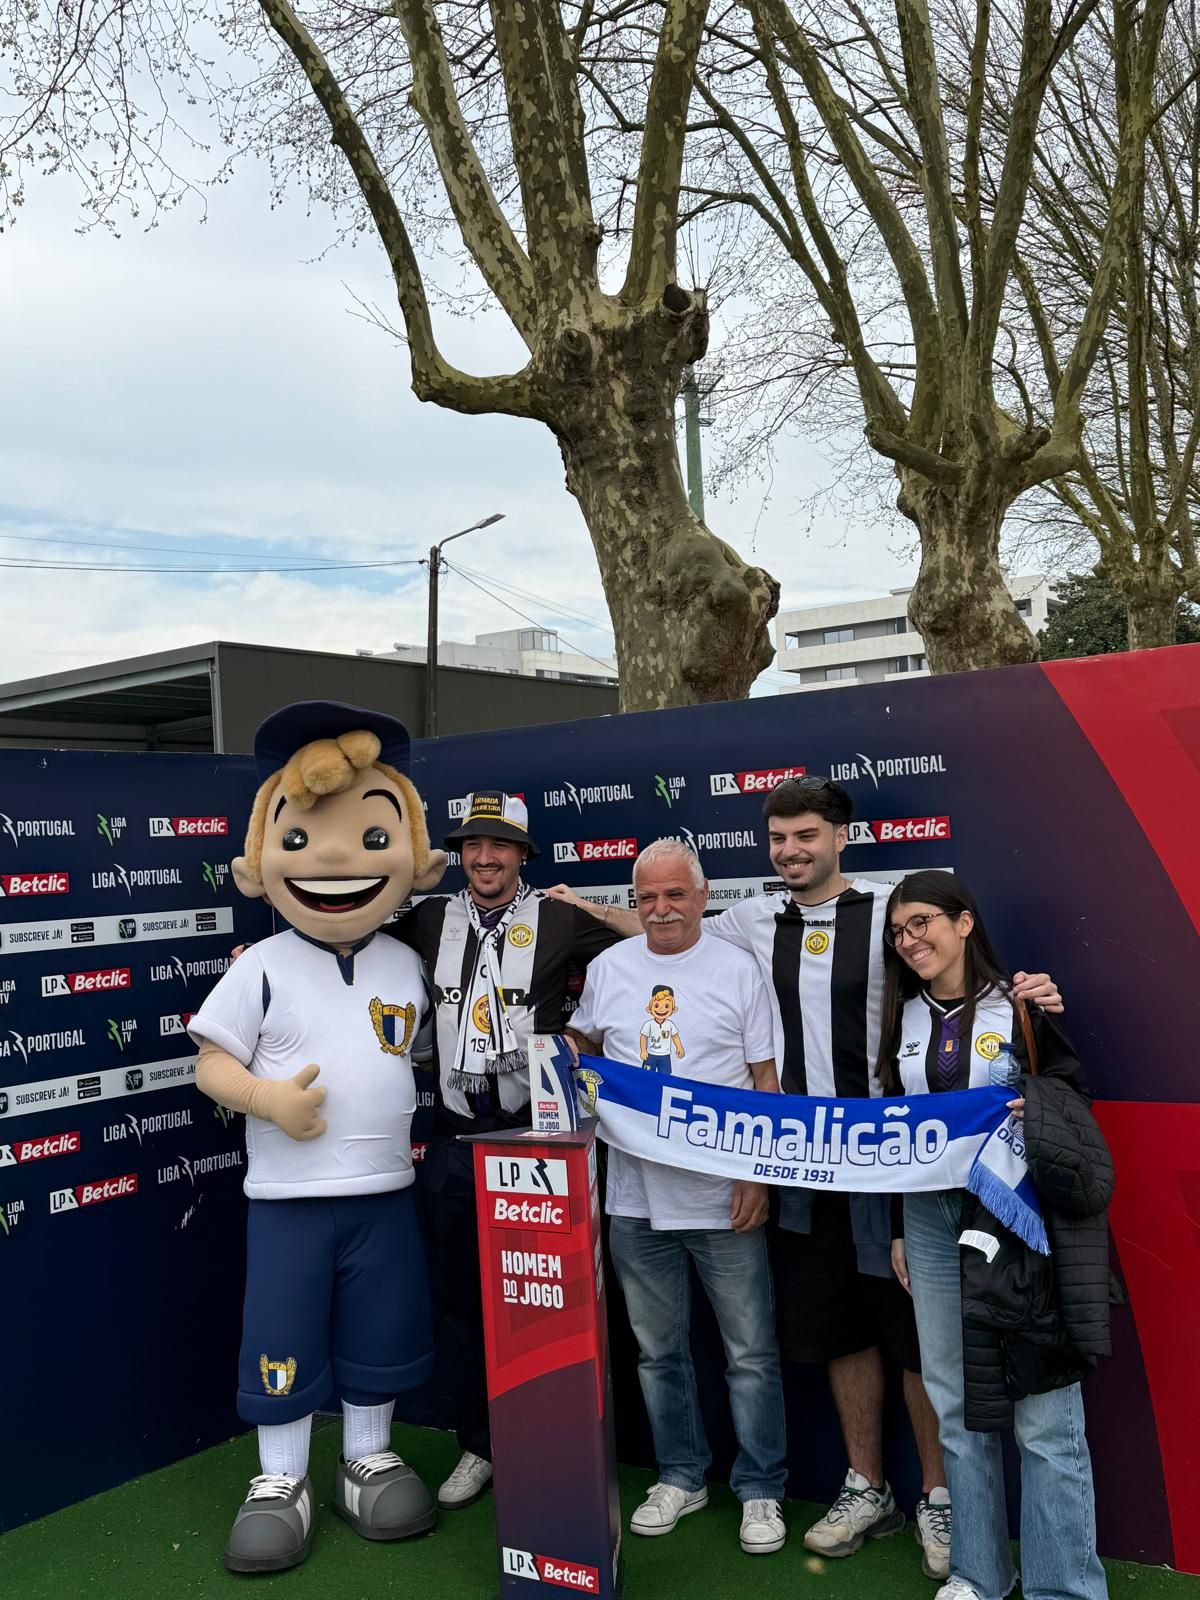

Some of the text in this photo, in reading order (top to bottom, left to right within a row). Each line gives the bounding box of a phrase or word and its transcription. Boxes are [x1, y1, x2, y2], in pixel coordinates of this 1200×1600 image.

[831, 755, 946, 782] LIGA PORTUGAL
[669, 776, 686, 788] LIGA
[714, 770, 803, 792] LP Betcli
[544, 784, 634, 808] LIGA PORTUGAL
[670, 788, 680, 800] TV
[450, 802, 462, 816] LP
[17, 820, 76, 837] PORTUGAL
[111, 816, 127, 828] LIGA
[152, 818, 226, 834] LP Betclic
[880, 818, 948, 840] Betclic
[112, 828, 121, 839] TV
[698, 830, 758, 850] PORTUGAL
[557, 840, 635, 860] LP Betclic
[214, 864, 229, 874] LIGA
[9, 874, 66, 894] Betclic
[92, 868, 182, 889] LIGA PORTUGAL
[216, 874, 224, 886] TV
[708, 887, 755, 900] BSCREVE JÁ!
[142, 918, 190, 932] SUBSCREVE JÁ!
[10, 928, 63, 944] SUBSCREVE JÁ!
[45, 970, 128, 994] LP Betclic
[150, 965, 174, 982] LIGA
[0, 992, 10, 1004] TV
[122, 1019, 138, 1032] LIGA
[162, 1018, 174, 1032] LP
[0, 1029, 86, 1058] GA PORTUGAL
[122, 1031, 132, 1044] TV
[149, 1066, 184, 1082] SUBSCREVE
[16, 1089, 56, 1106] SUBSCREVE
[58, 1086, 70, 1098] JÁ!
[538, 1112, 560, 1120] HOMEM
[104, 1110, 193, 1142] LIGA PORTUGAL
[544, 1121, 560, 1130] JOGO
[657, 1086, 949, 1166] Famalicão
[20, 1134, 78, 1160] Betclic
[158, 1150, 243, 1184] LIGA PORTUGAL
[499, 1162, 520, 1188] LP
[753, 1162, 836, 1184] DESDE 1931
[52, 1178, 136, 1210] LP Betclic
[8, 1200, 25, 1214] LIGA
[494, 1198, 564, 1225] Betclic
[8, 1214, 18, 1226] TV
[501, 1250, 562, 1279] HOMEM
[503, 1278, 564, 1309] DO JOGO
[510, 1552, 524, 1573] LP
[544, 1562, 594, 1588] Betclic
